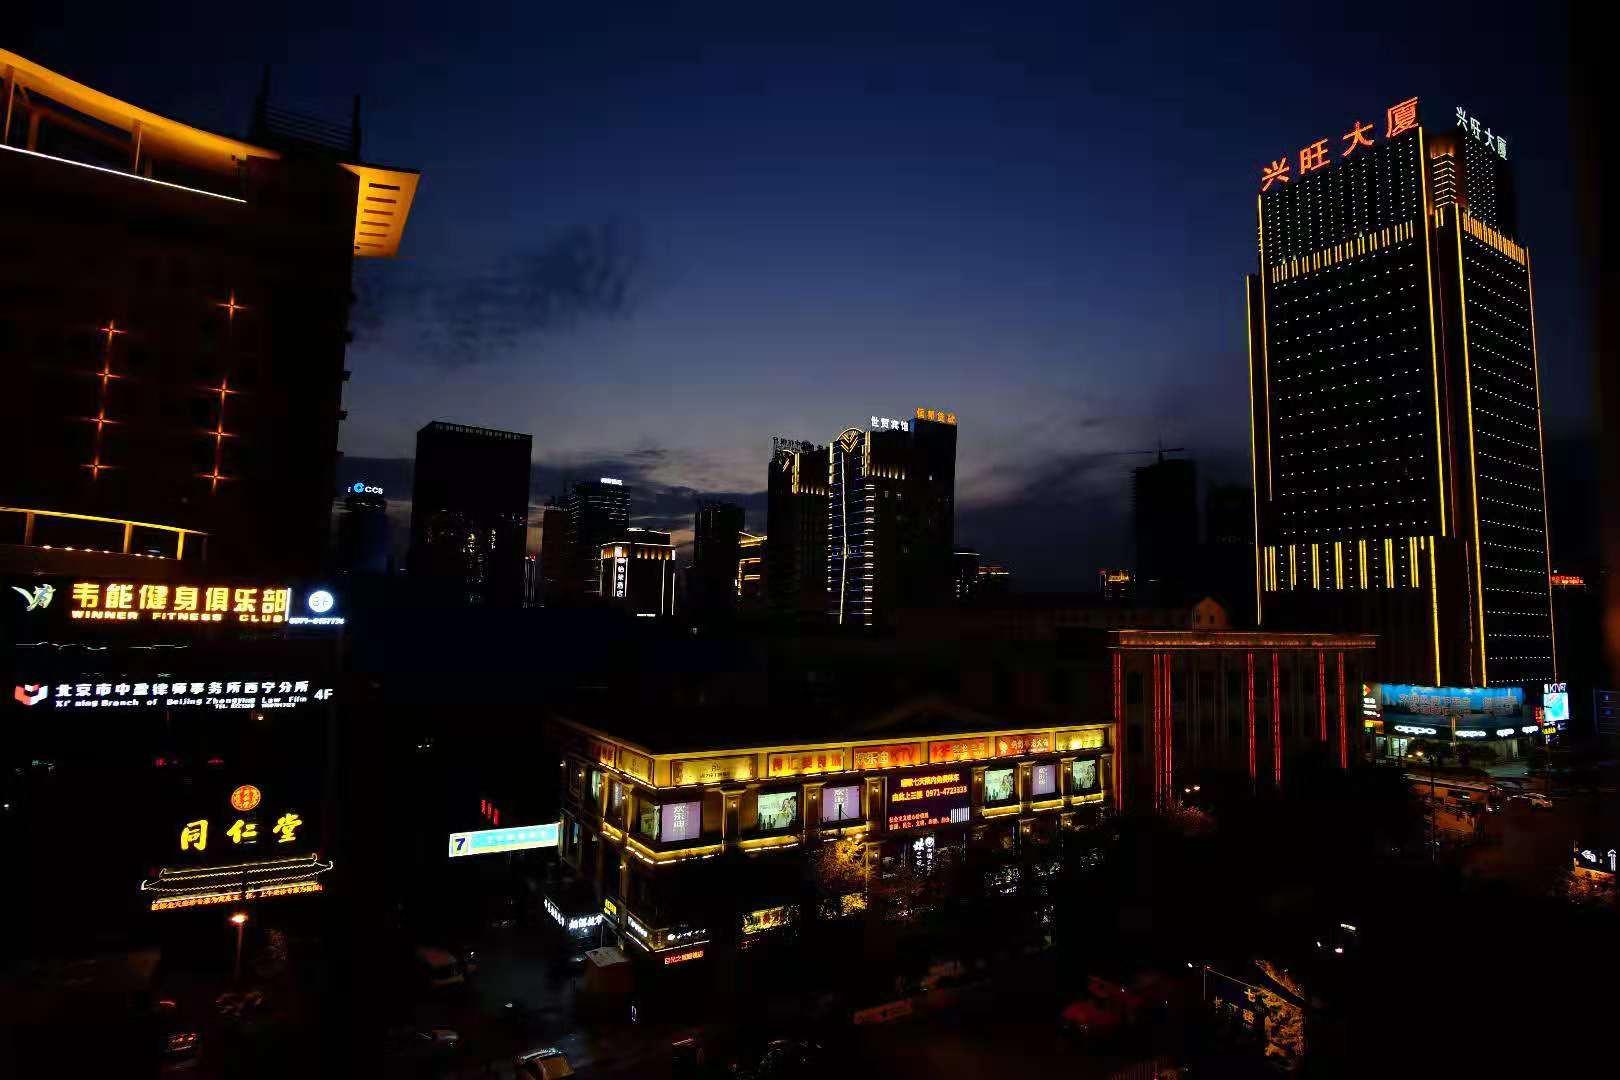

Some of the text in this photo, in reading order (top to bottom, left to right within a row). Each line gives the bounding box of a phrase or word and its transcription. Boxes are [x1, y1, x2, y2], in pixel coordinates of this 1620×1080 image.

[1455, 106, 1508, 160] 兴旺大厦
[1261, 96, 1420, 192] 兴旺大厦
[72, 583, 287, 614] 韦能健身俱乐部
[72, 611, 283, 623] WINNER FITNESS CLUB
[166, 698, 203, 706] Beijing
[261, 696, 281, 704] Law
[314, 688, 333, 700] 4F
[180, 813, 303, 850] 同仁堂
[456, 838, 465, 850] 7
